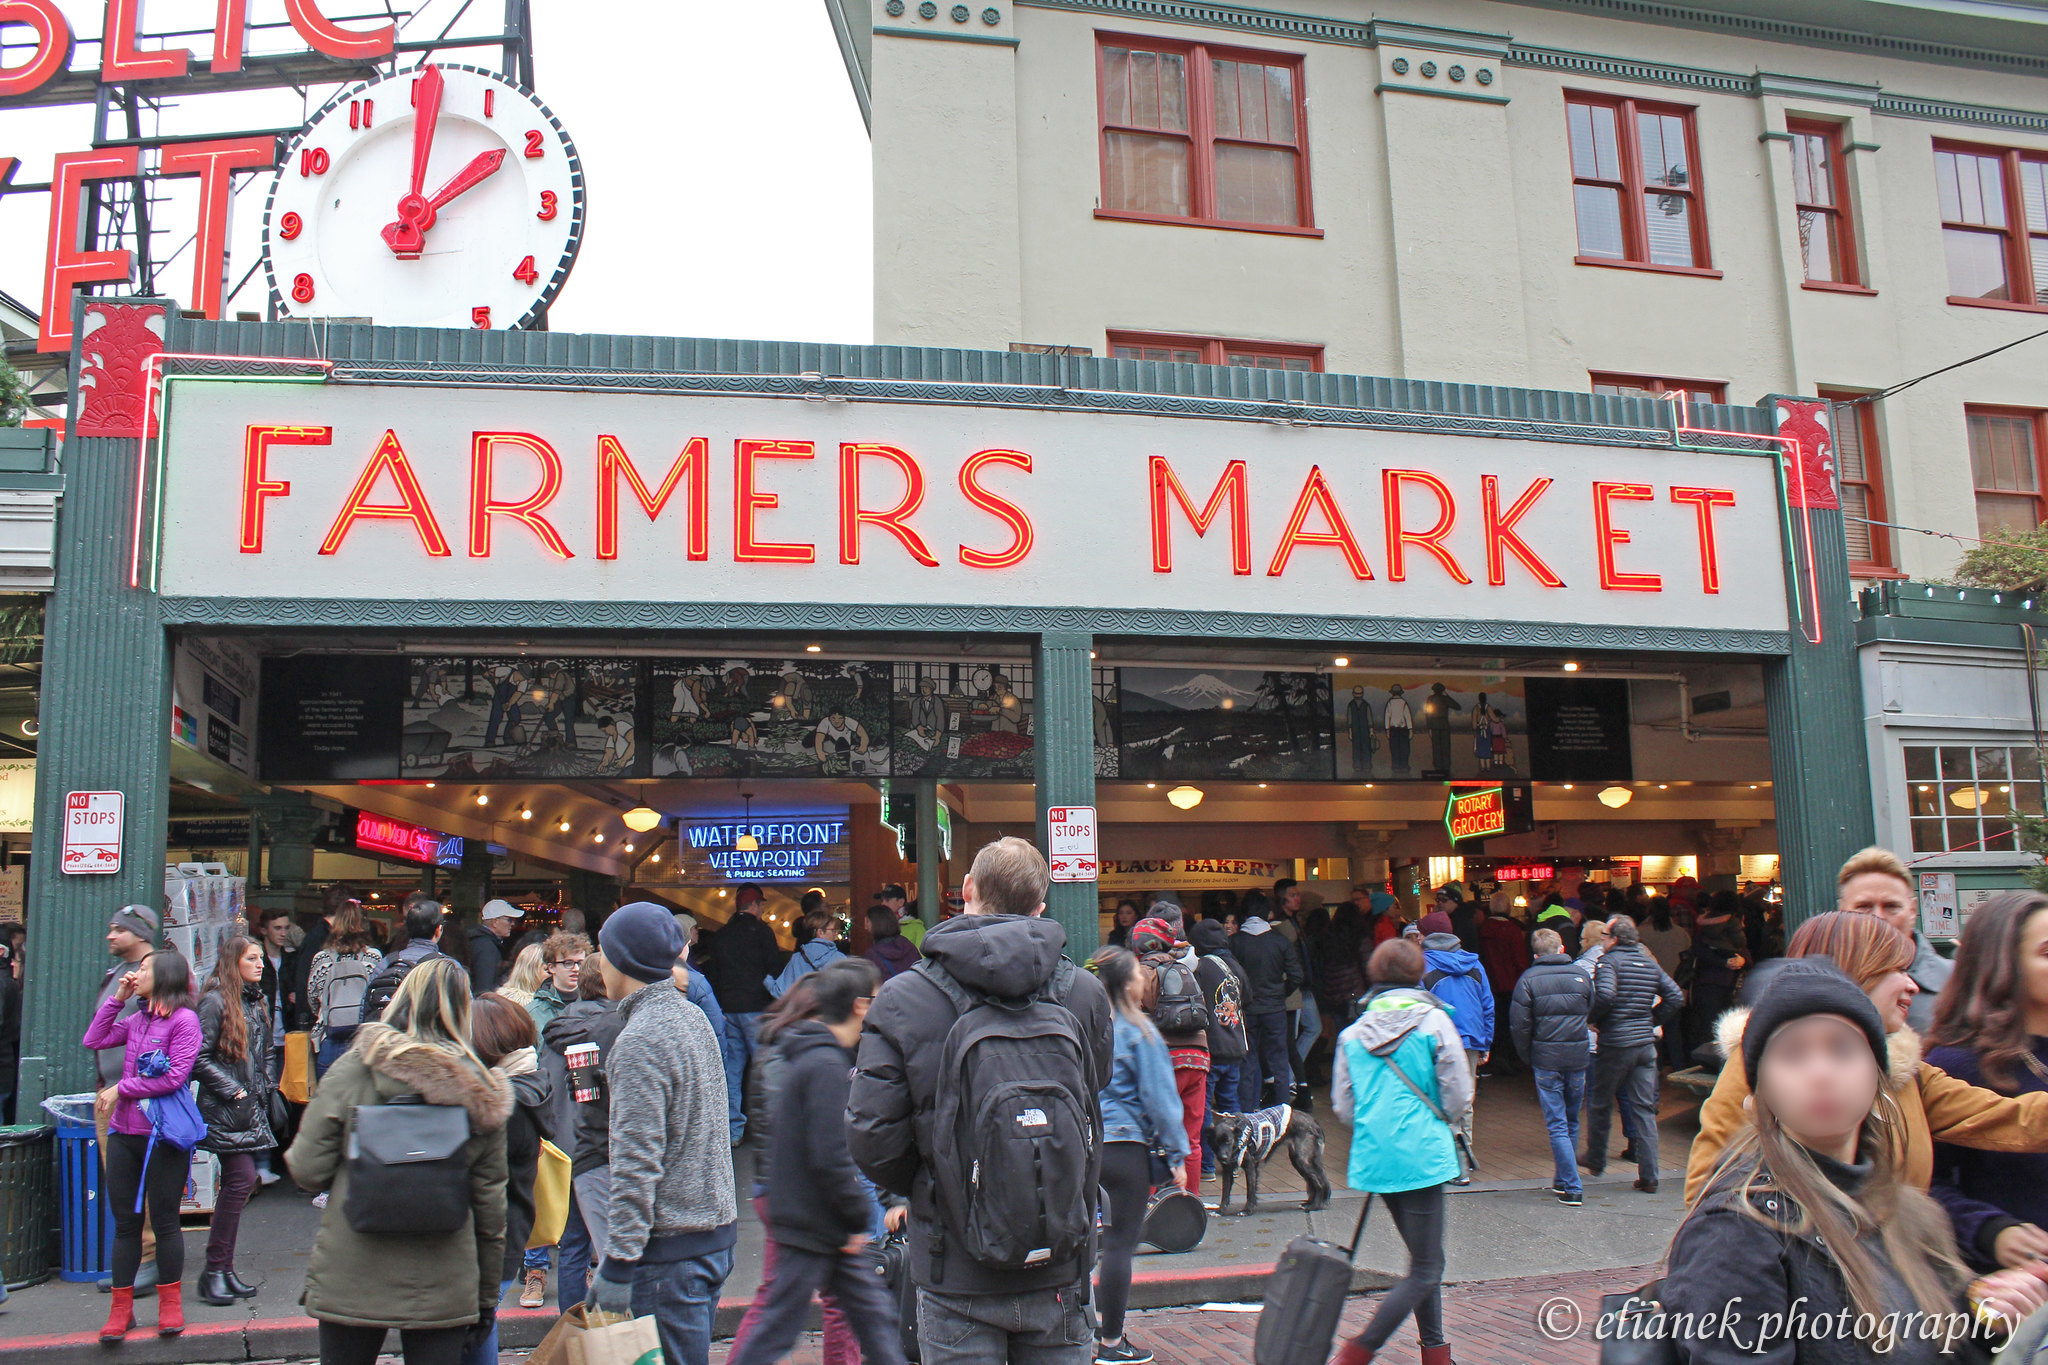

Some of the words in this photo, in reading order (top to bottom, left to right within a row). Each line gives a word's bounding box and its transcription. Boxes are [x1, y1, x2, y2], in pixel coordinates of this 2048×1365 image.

[349, 98, 374, 130] 11
[484, 89, 494, 117] 1
[524, 130, 544, 159] 2
[300, 147, 330, 177] 10
[536, 190, 558, 221] 3
[279, 211, 303, 240] 9
[513, 255, 539, 286] 4
[291, 273, 315, 303] 8
[470, 306, 491, 330] 5
[240, 424, 1034, 567] FARMERS
[1148, 455, 1736, 594] MARKET
[71, 796, 86, 806] NO
[1458, 793, 1494, 815] ROTARY
[73, 812, 115, 825] STOPS
[1051, 811, 1064, 820] NO
[1452, 810, 1504, 836] GROCERY
[688, 822, 844, 848] WATERFRONT
[1055, 825, 1090, 837] STOPS
[709, 849, 823, 869] VIEWPOINT
[1101, 859, 1174, 874] PLACE
[1184, 859, 1279, 877] BAKERY
[726, 870, 732, 878] &
[734, 870, 765, 878] PUBLIC
[767, 869, 805, 877] SEATING
[1497, 867, 1553, 880] BAR-B-QUE
[1930, 920, 1952, 930] TIME
